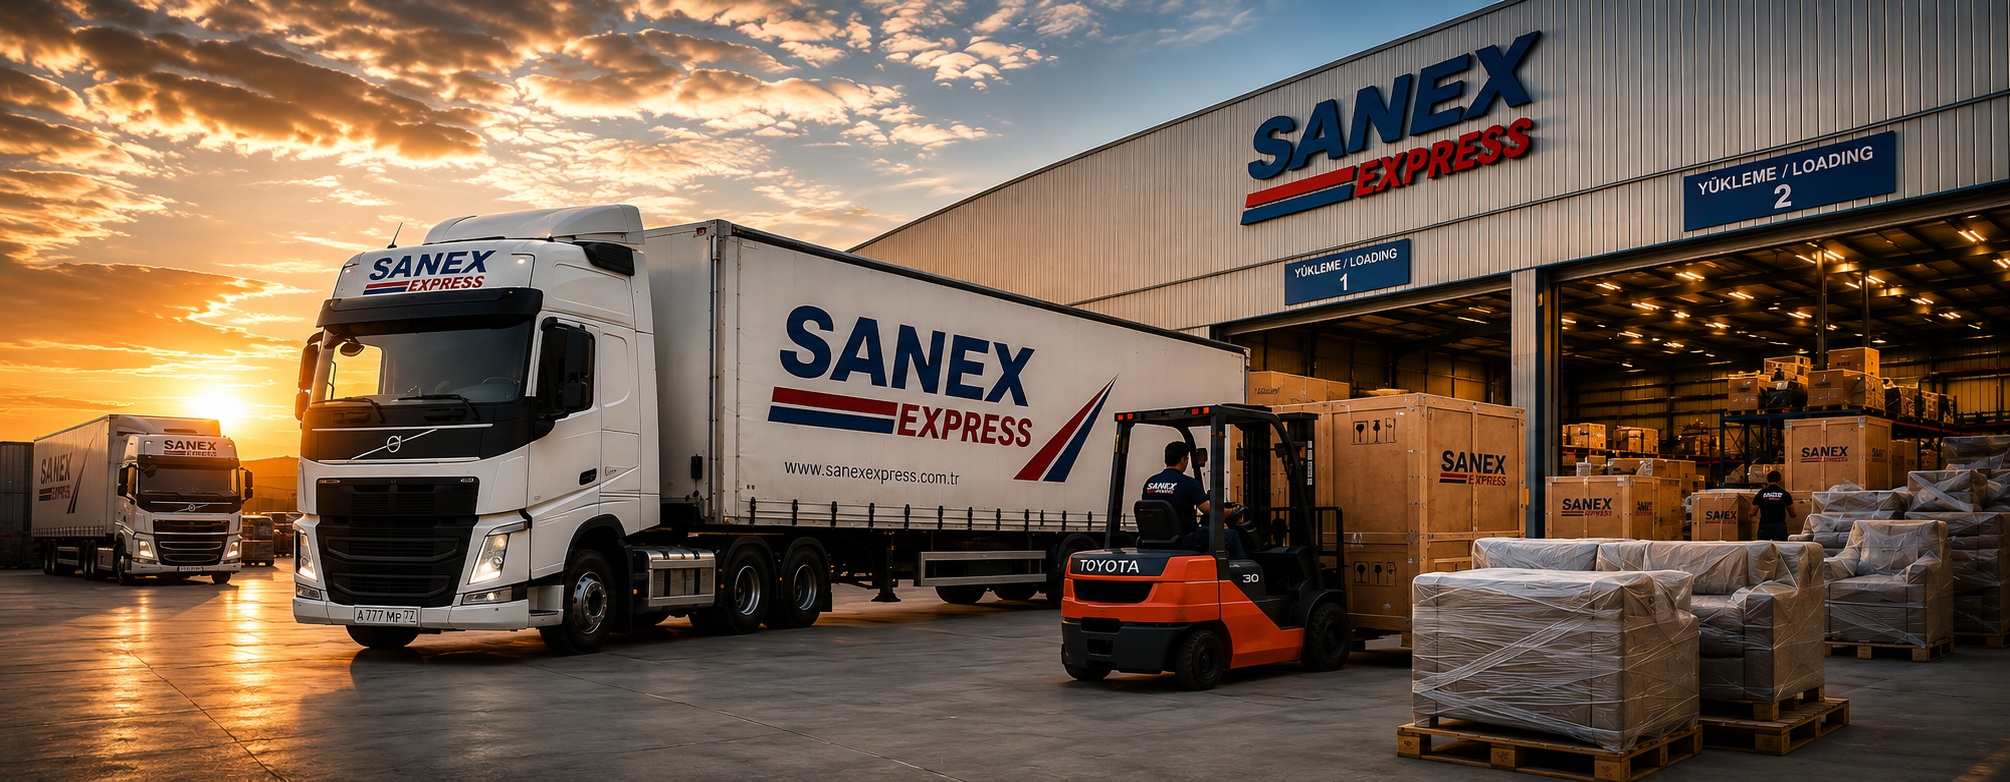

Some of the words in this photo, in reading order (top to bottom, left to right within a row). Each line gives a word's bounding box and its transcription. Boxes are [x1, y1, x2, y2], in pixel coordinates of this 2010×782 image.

[1248, 30, 1542, 180] SANEX
[1355, 117, 1533, 198] EXPRESS
[1698, 166, 1777, 195] YÜKLEME
[1782, 164, 1789, 178] /
[1792, 145, 1874, 176] LOADING
[1774, 183, 1792, 209] 2
[369, 250, 496, 281] SANEX
[1294, 260, 1341, 278] YÜKLEME
[1343, 258, 1348, 269] /
[1350, 248, 1398, 268] LOADING
[407, 275, 485, 292] EXPRESS
[1340, 273, 1348, 291] 1
[779, 305, 1036, 407] SANEX
[897, 402, 1033, 448] EXPRESS
[164, 439, 217, 451] SANEX
[1801, 446, 1848, 458] SANEX
[41, 452, 73, 485] SANEX
[784, 461, 960, 486] www.sanexexpress.com.tr
[1441, 450, 1507, 475] SANEX
[1468, 474, 1507, 487] EXPRESS
[1562, 498, 1613, 511] SANEX
[1079, 559, 1140, 574] TOYOTA
[1242, 573, 1259, 583] 30
[357, 609, 364, 621] A
[365, 609, 384, 622] 777
